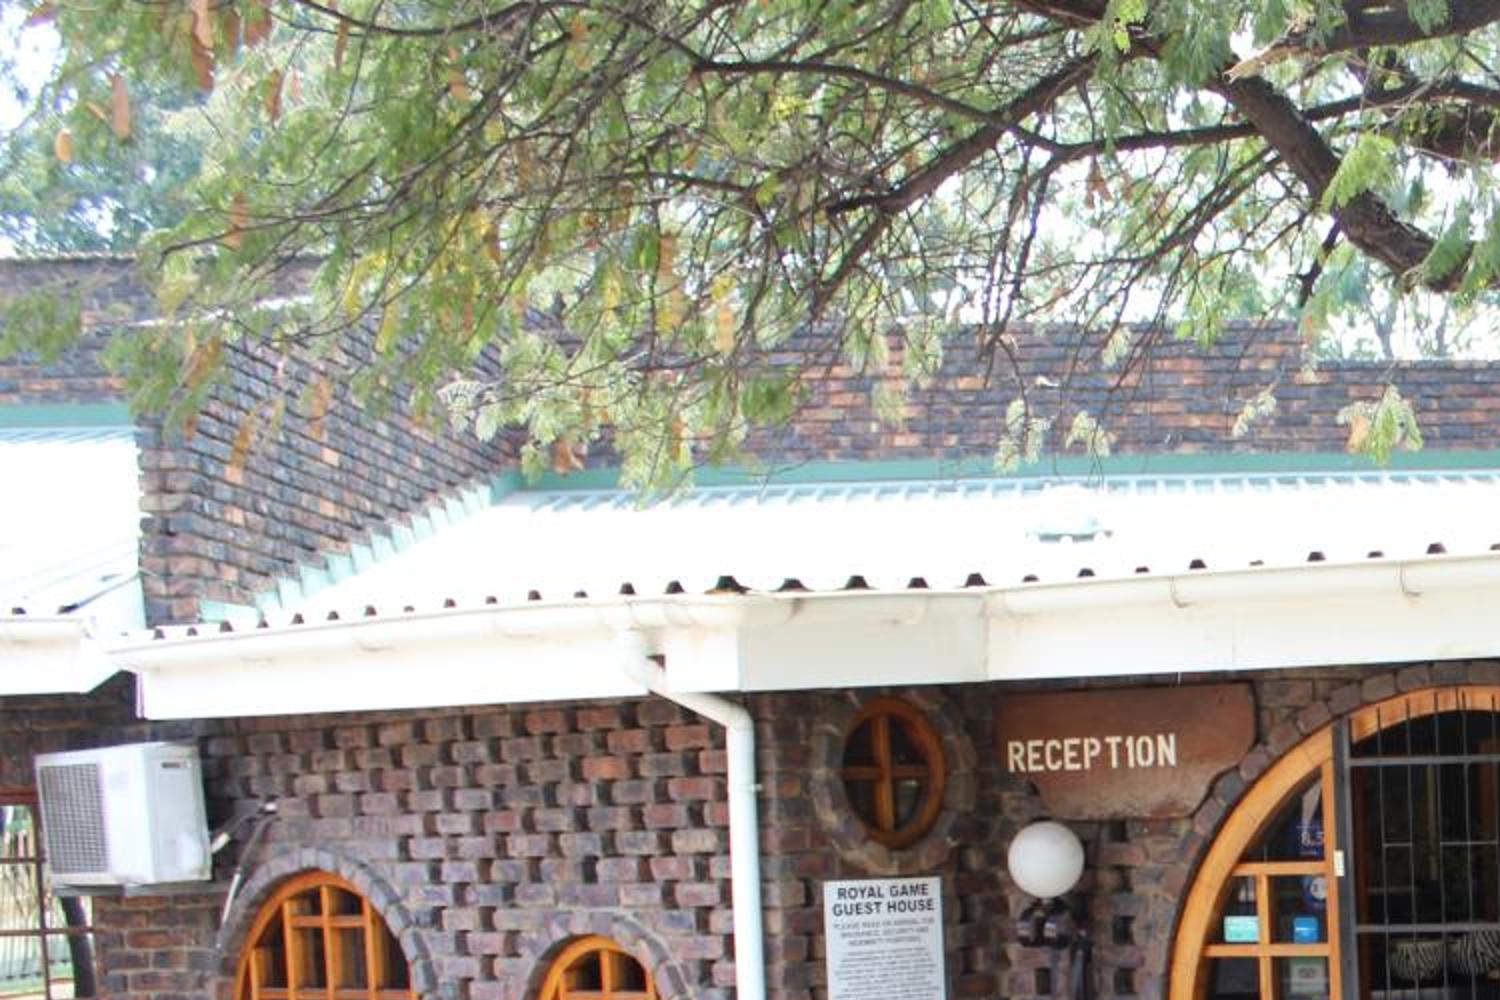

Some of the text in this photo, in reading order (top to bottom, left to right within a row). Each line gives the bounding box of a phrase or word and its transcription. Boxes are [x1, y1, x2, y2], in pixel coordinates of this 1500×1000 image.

[837, 883, 929, 900] ROYAL GAME
[832, 898, 935, 917] GUEST HOUSE
